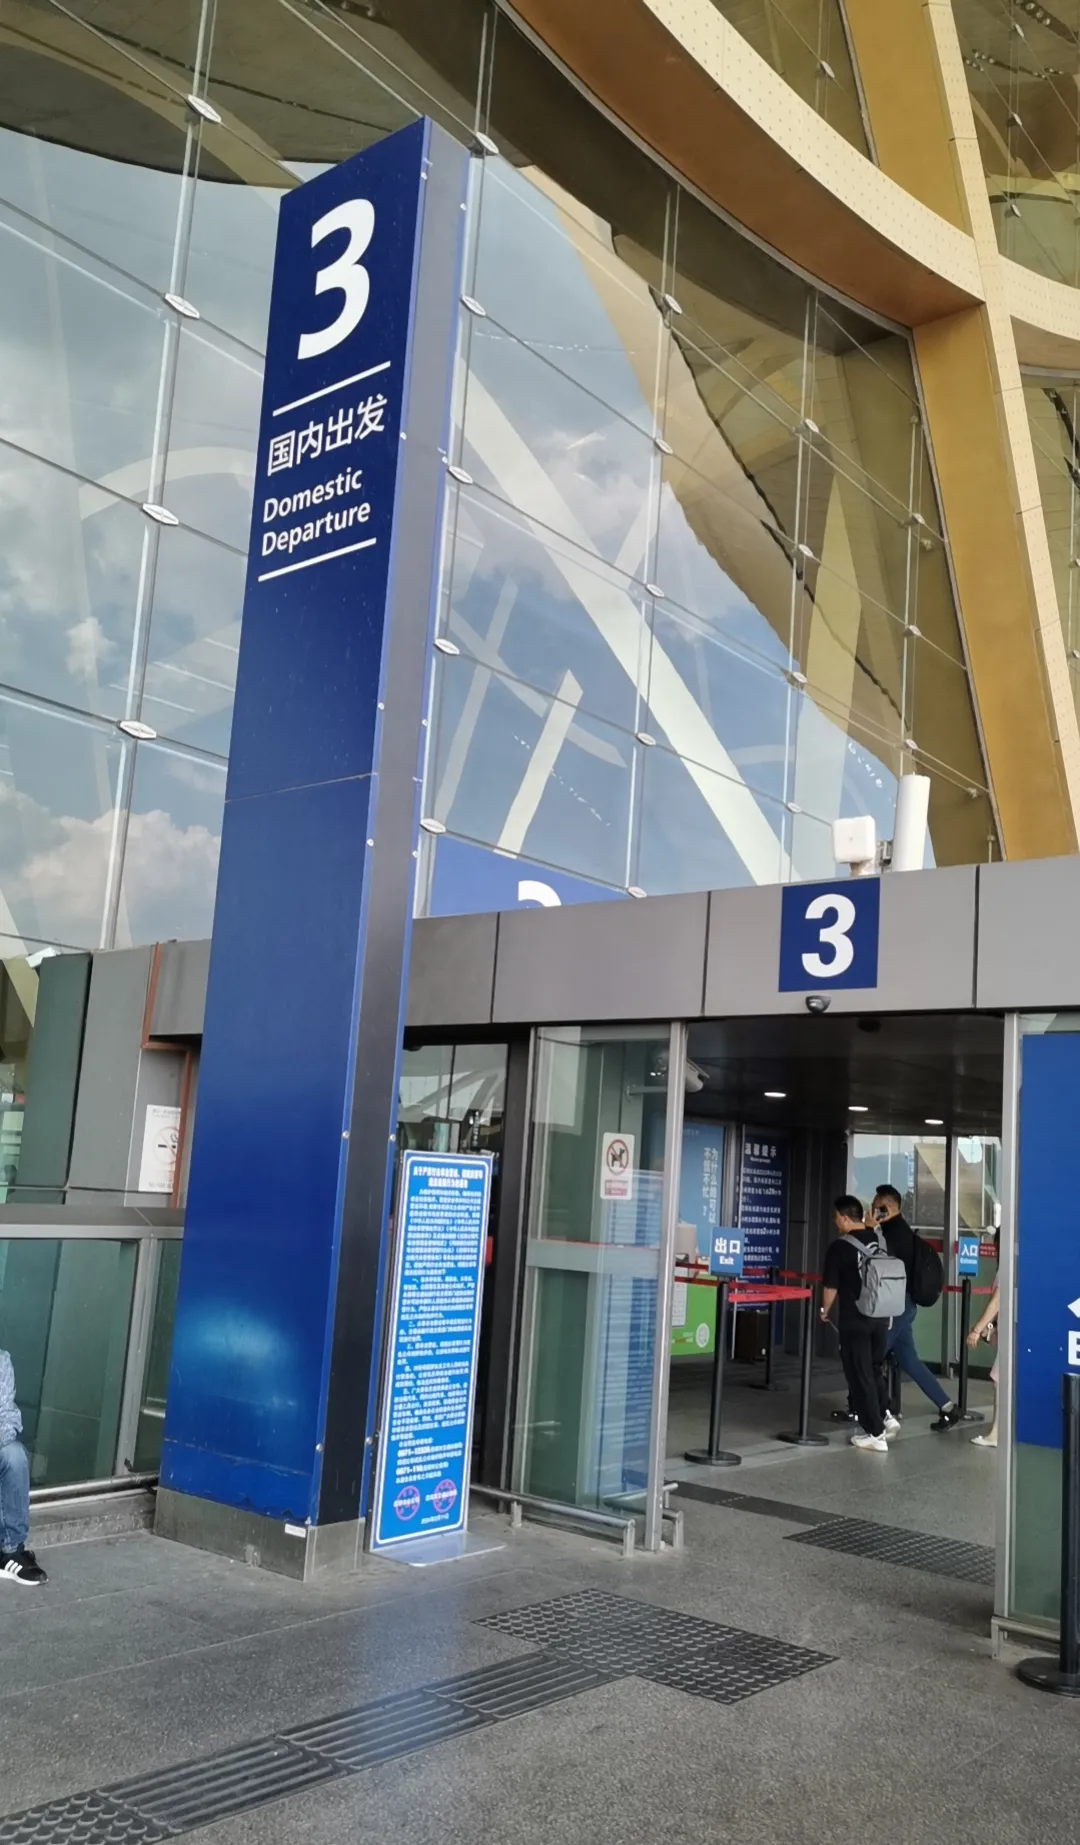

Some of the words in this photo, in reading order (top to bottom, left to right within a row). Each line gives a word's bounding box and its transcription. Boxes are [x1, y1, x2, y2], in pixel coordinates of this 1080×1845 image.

[297, 198, 375, 360] 3
[267, 394, 387, 475] 国内出发
[262, 466, 363, 523] Domestic
[261, 502, 371, 557] Departure
[801, 893, 856, 978] 3
[714, 1237, 741, 1255] 出口
[719, 1255, 735, 1266] Exit
[961, 1243, 978, 1257] 入口
